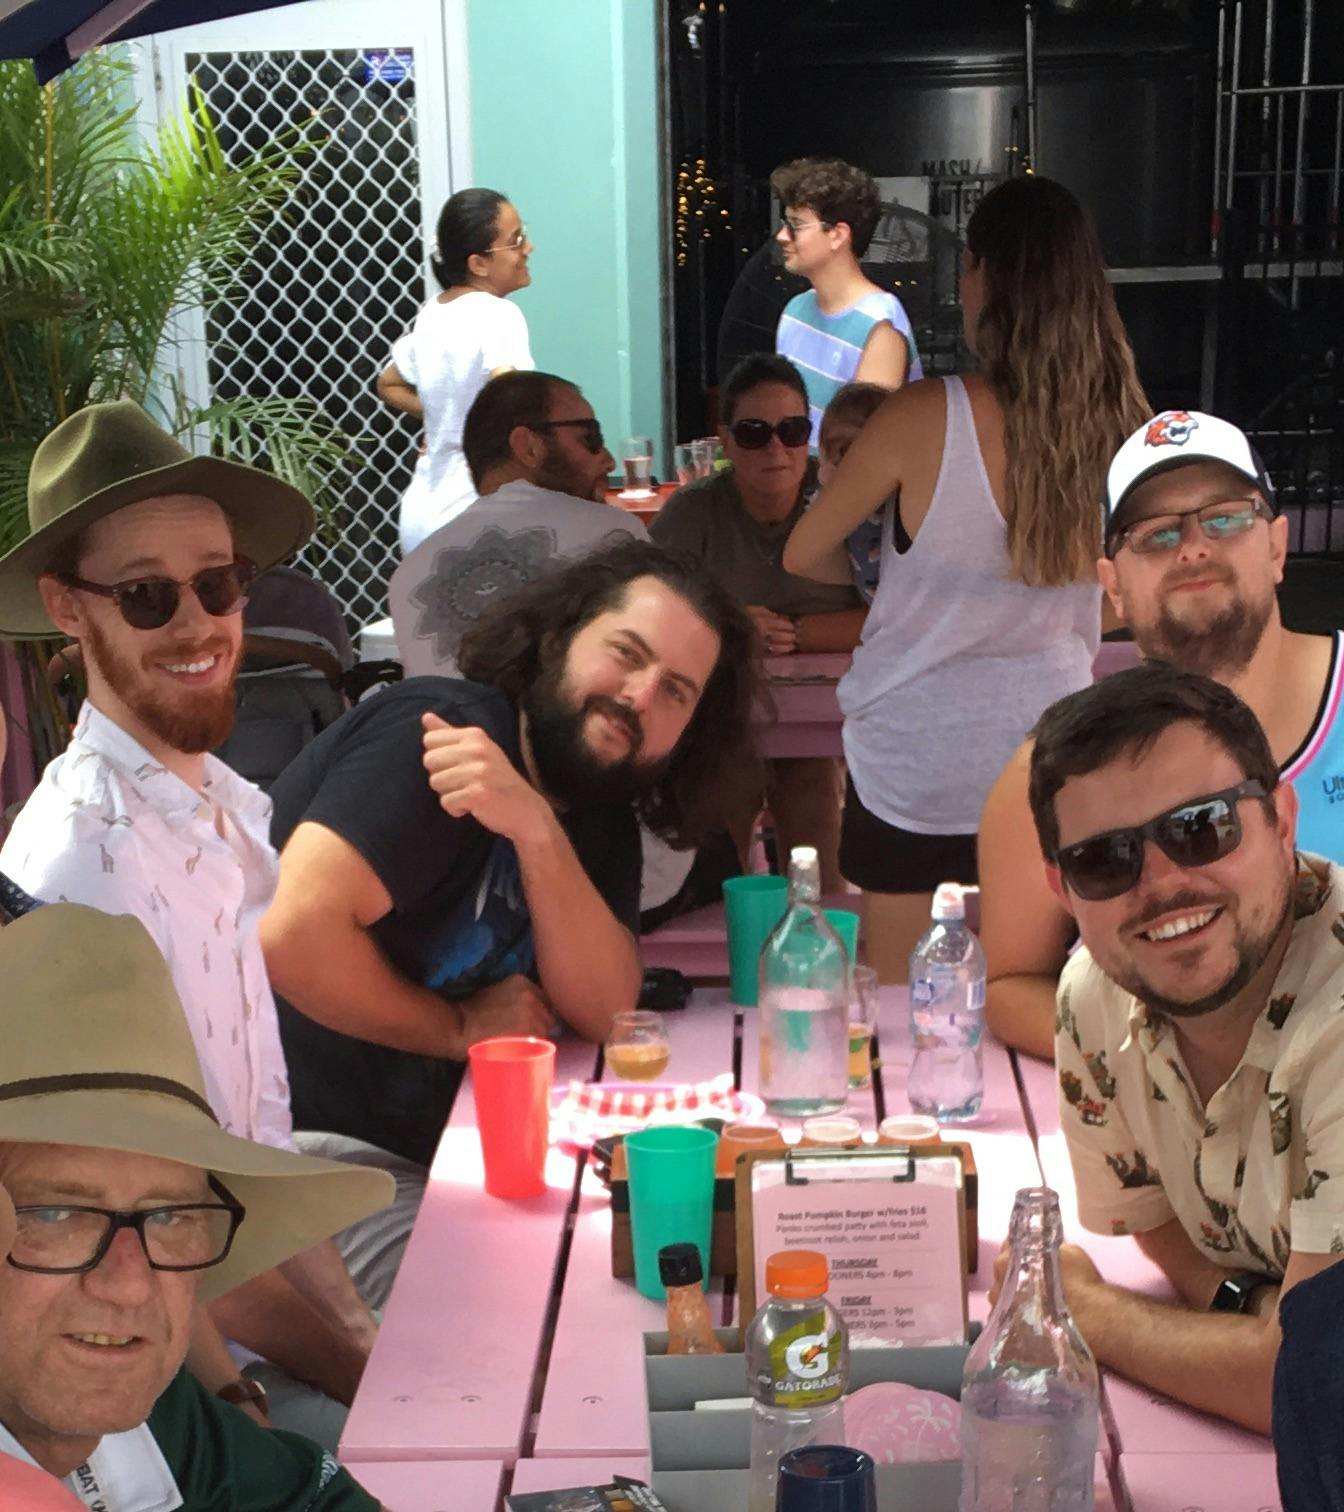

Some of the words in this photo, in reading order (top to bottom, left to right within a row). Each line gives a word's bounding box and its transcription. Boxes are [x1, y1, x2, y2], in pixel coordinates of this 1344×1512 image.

[777, 1212, 803, 1221] Roast
[805, 1210, 844, 1220] Pumpkin
[846, 1209, 874, 1219] Burger
[845, 1223, 867, 1232] patty
[869, 1220, 887, 1229] with
[879, 1232, 896, 1241] and
[897, 1231, 920, 1241] salad
[832, 1258, 878, 1269] THURSDAY
[841, 1296, 872, 1306] FRIDAY
[775, 1373, 842, 1392] GATORADE
